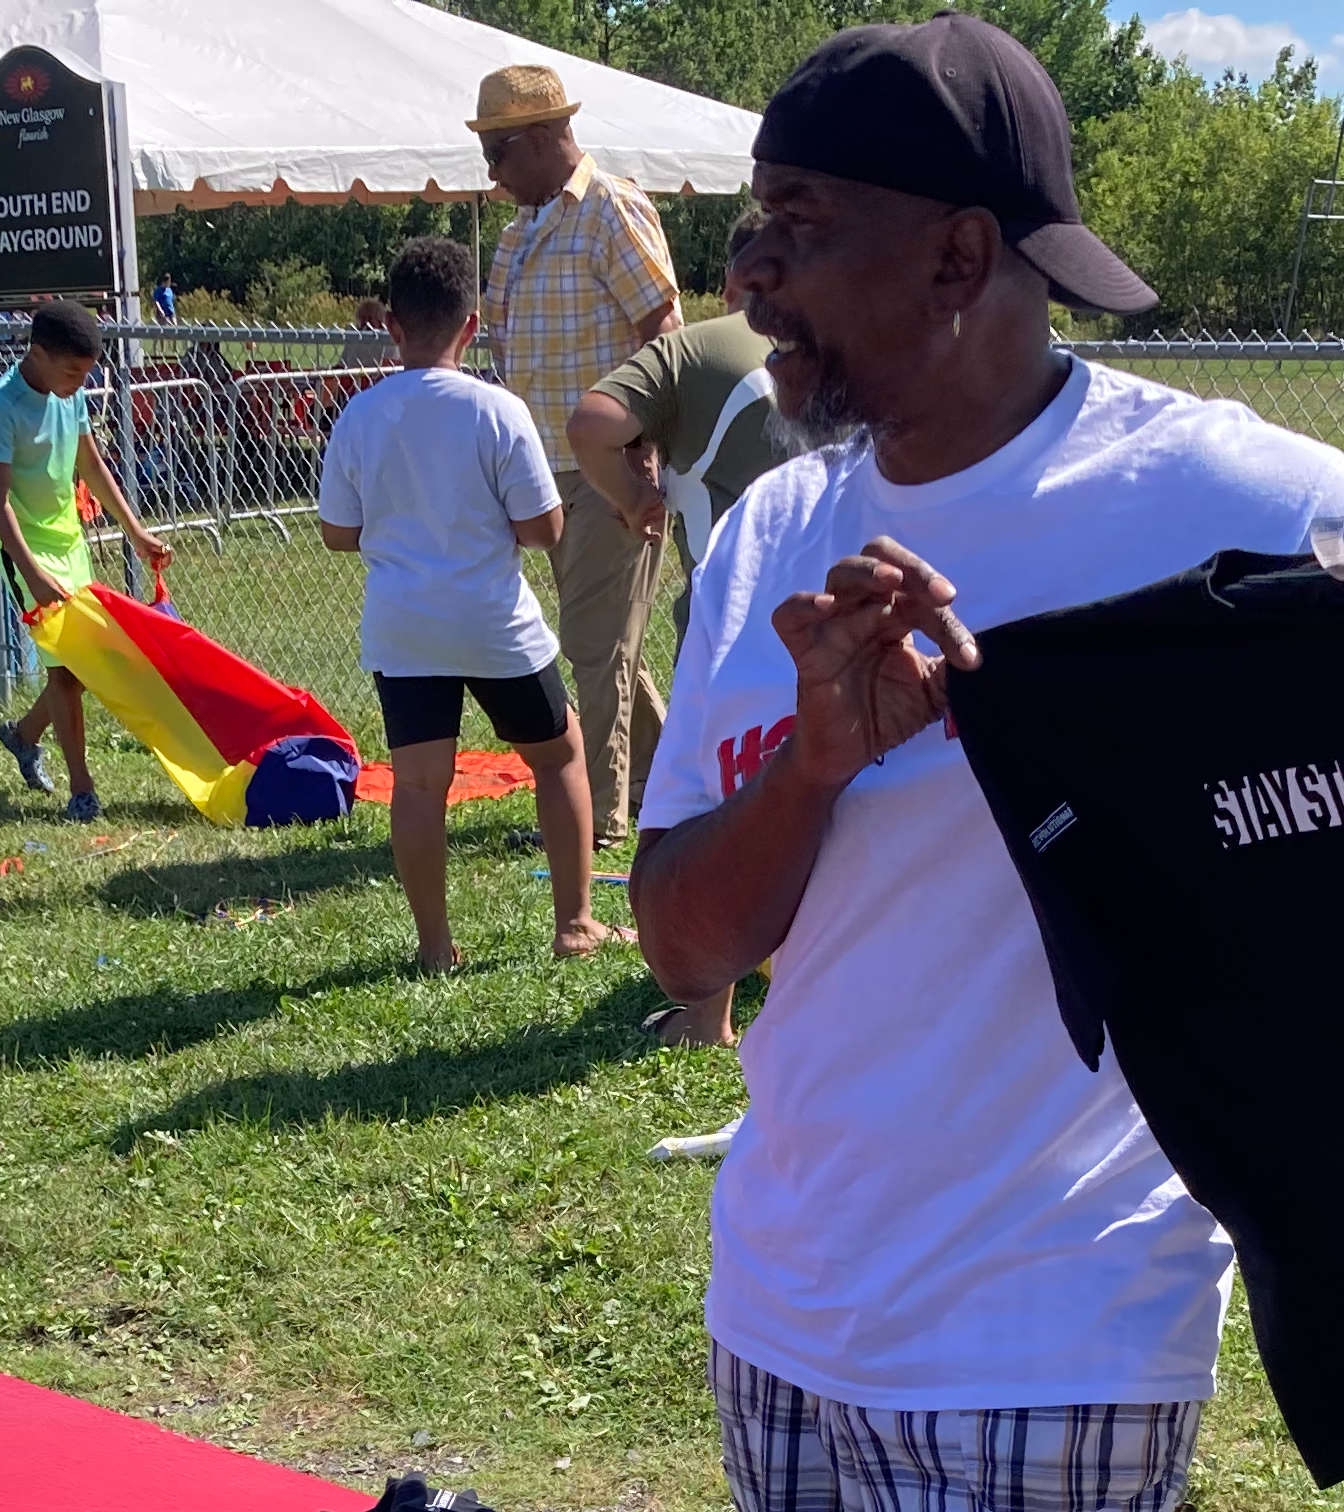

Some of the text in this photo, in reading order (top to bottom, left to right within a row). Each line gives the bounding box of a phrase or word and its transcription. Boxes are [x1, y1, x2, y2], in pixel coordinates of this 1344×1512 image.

[22, 106, 65, 125] Glasgow
[51, 189, 91, 213] END
[1203, 768, 1294, 850] STAY
